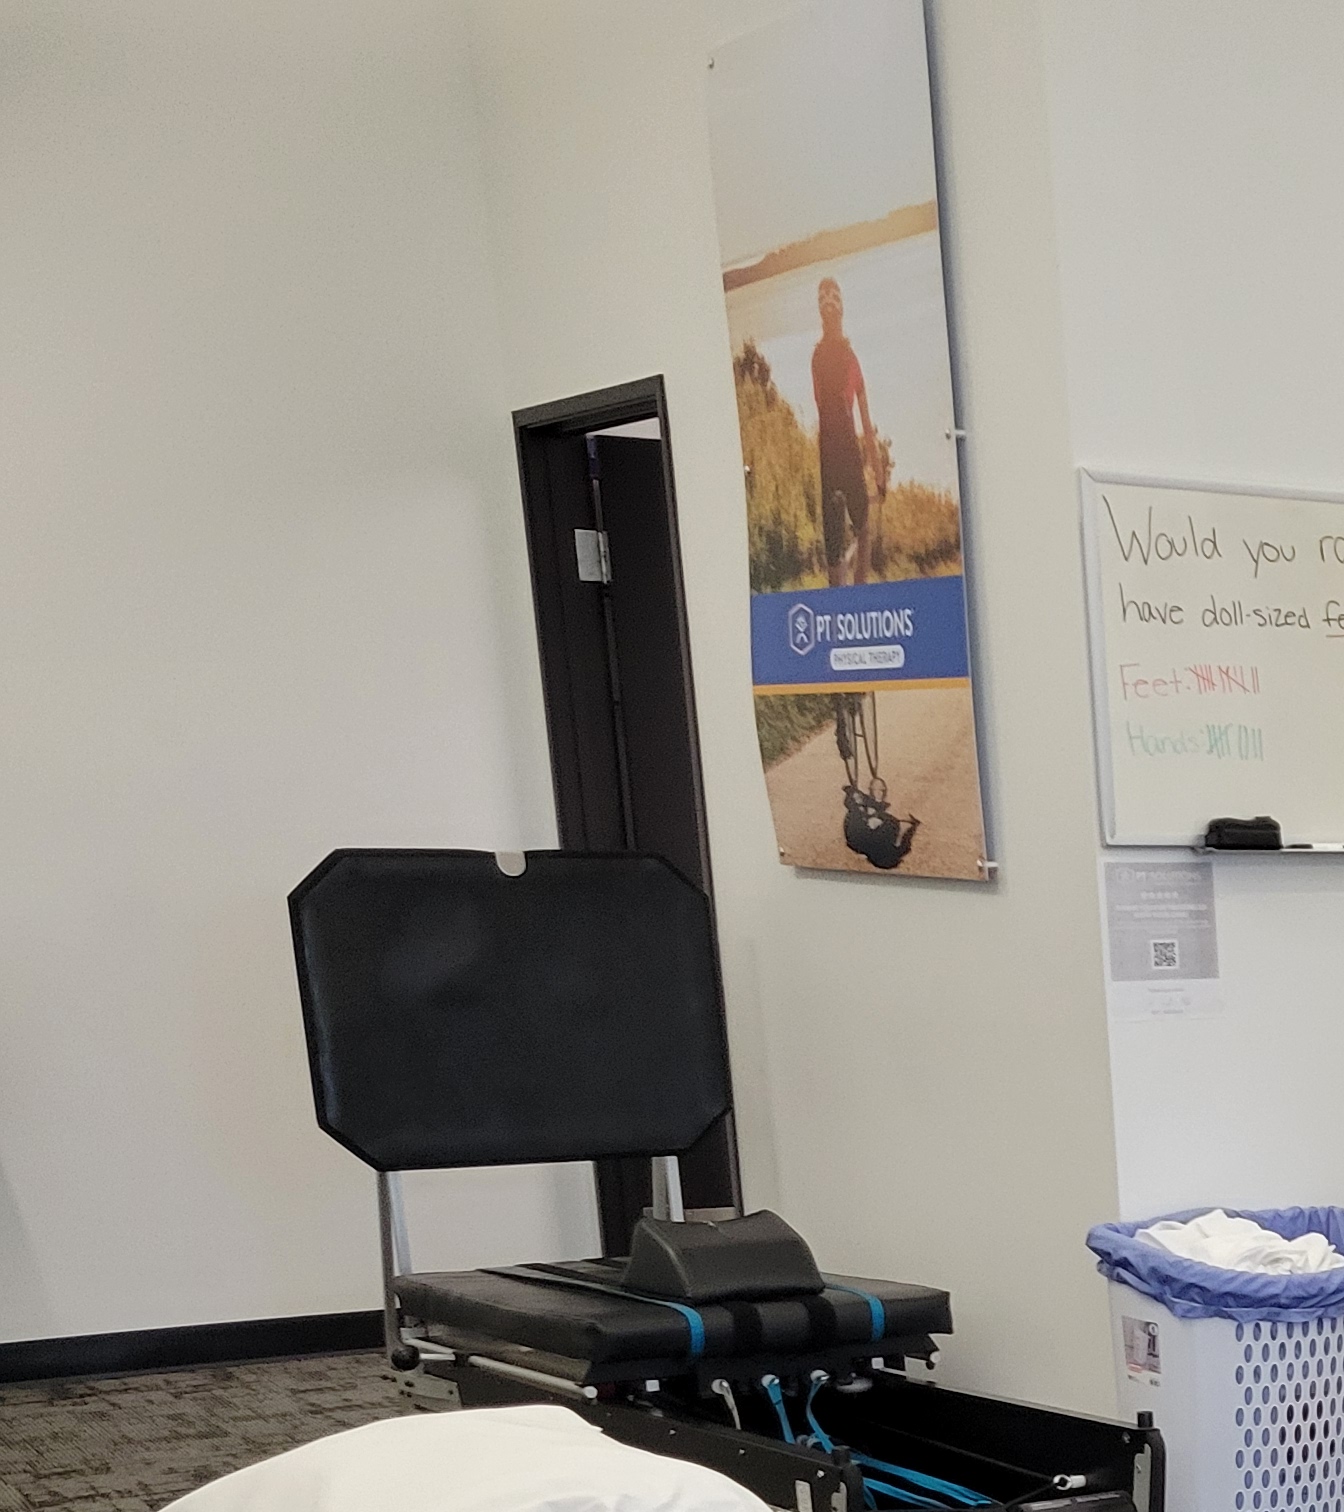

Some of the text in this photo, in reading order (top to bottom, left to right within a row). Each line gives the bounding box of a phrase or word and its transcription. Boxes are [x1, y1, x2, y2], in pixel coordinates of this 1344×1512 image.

[1102, 495, 1222, 565] Would
[1243, 538, 1296, 579] you
[816, 608, 914, 642] PT SOLUTIONS
[1119, 582, 1184, 625] have
[1201, 594, 1311, 630] doll-sized
